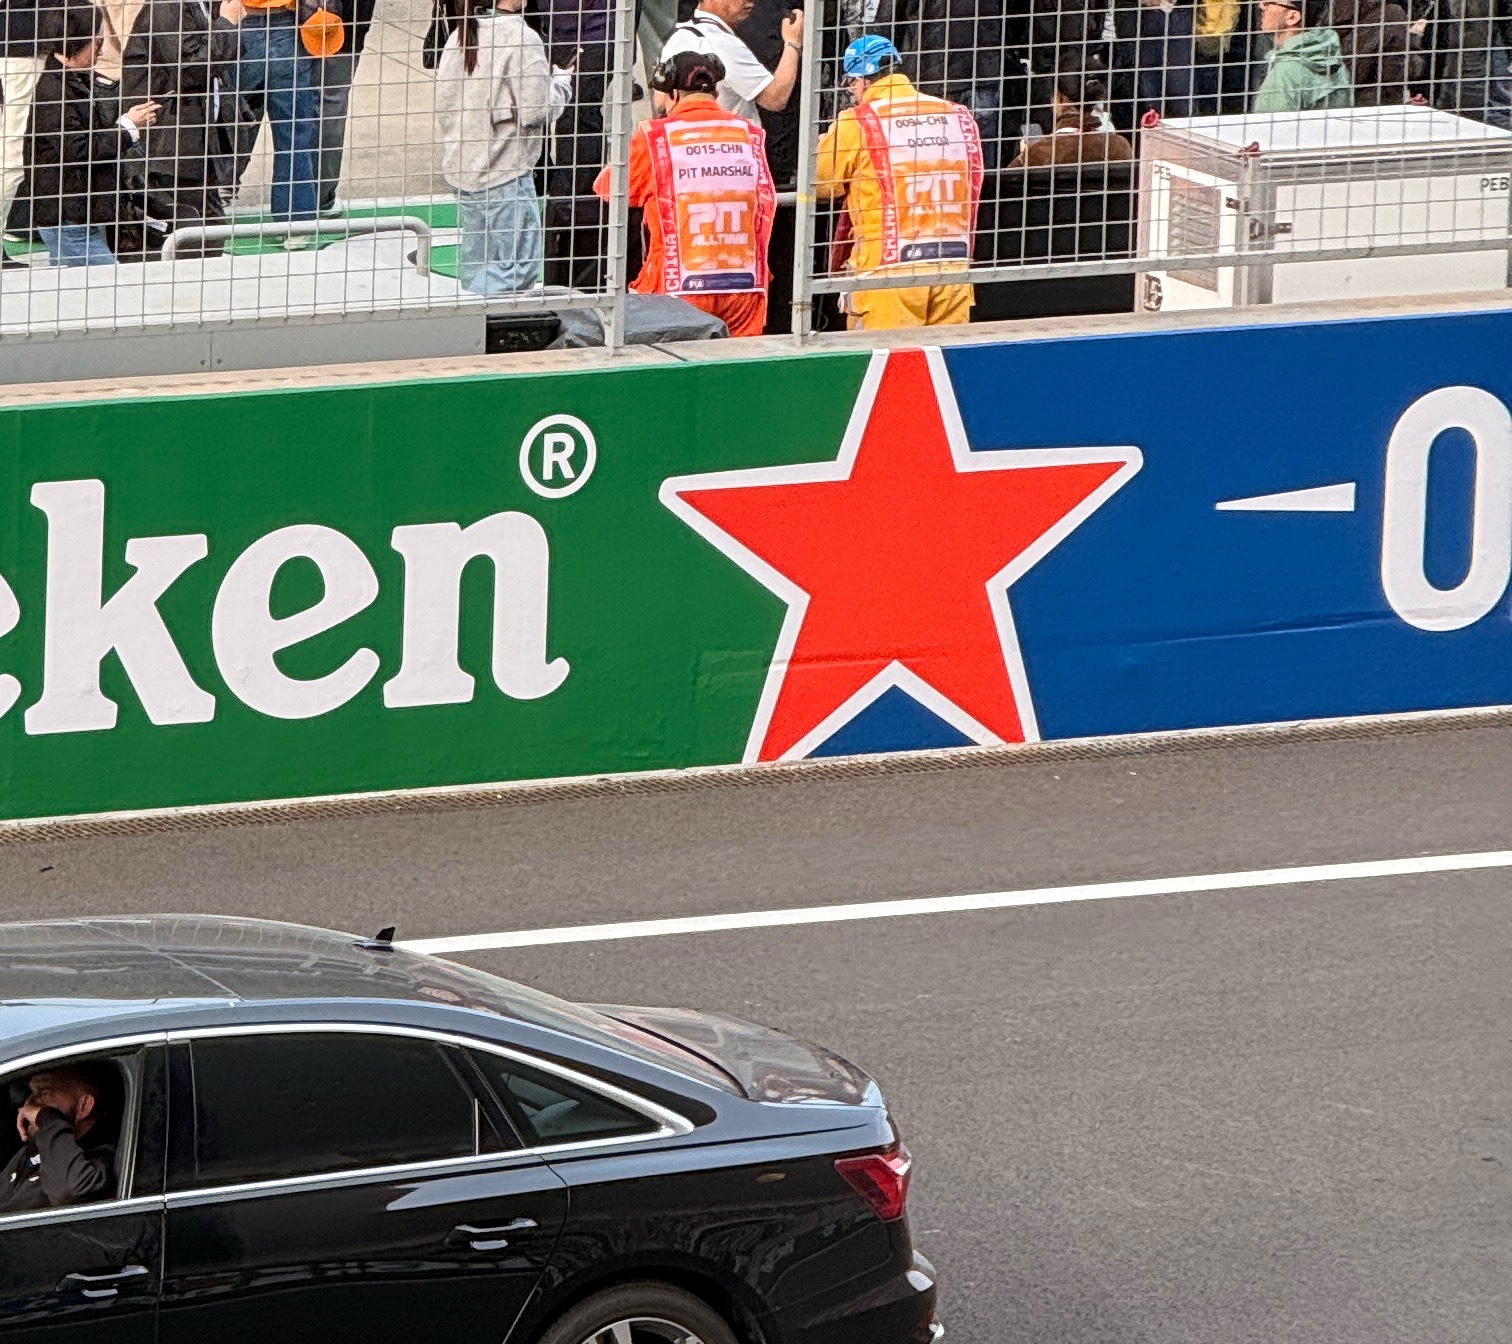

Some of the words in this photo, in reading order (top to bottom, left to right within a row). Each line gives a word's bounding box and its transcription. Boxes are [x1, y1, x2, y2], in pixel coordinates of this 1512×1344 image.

[678, 167, 698, 180] PIT
[701, 165, 754, 178] MARSHAL
[904, 172, 961, 204] PIT
[687, 201, 749, 235] PIT
[665, 233, 680, 291] CHINA
